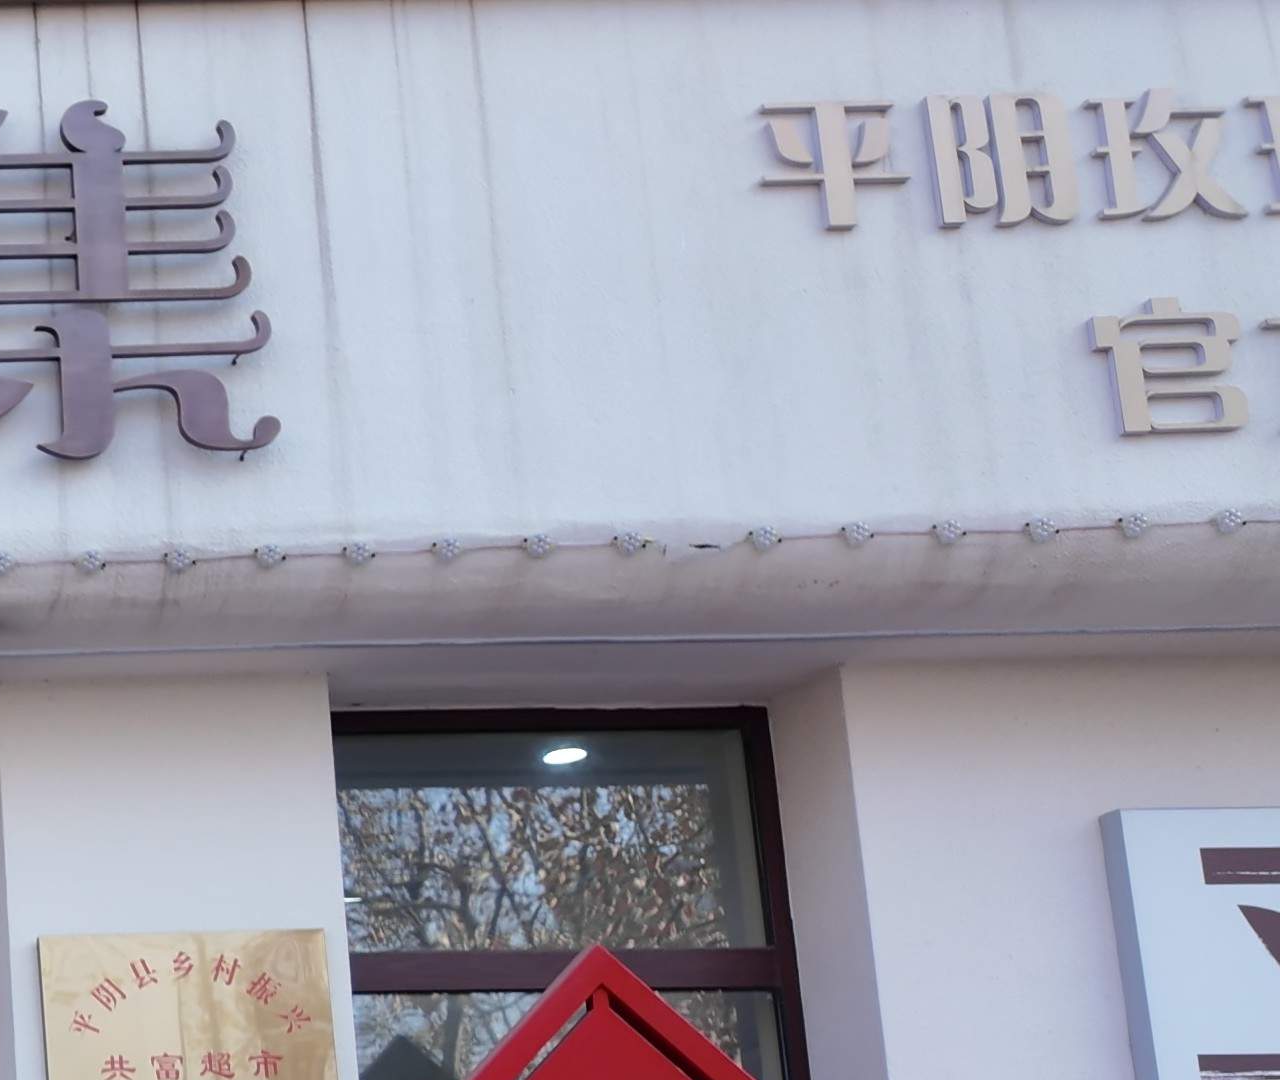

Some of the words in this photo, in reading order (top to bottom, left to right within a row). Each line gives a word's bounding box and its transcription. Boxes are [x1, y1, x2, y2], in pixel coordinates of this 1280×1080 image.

[1087, 296, 1280, 437] 官
[68, 951, 312, 1035] 平阴县乡村振兴
